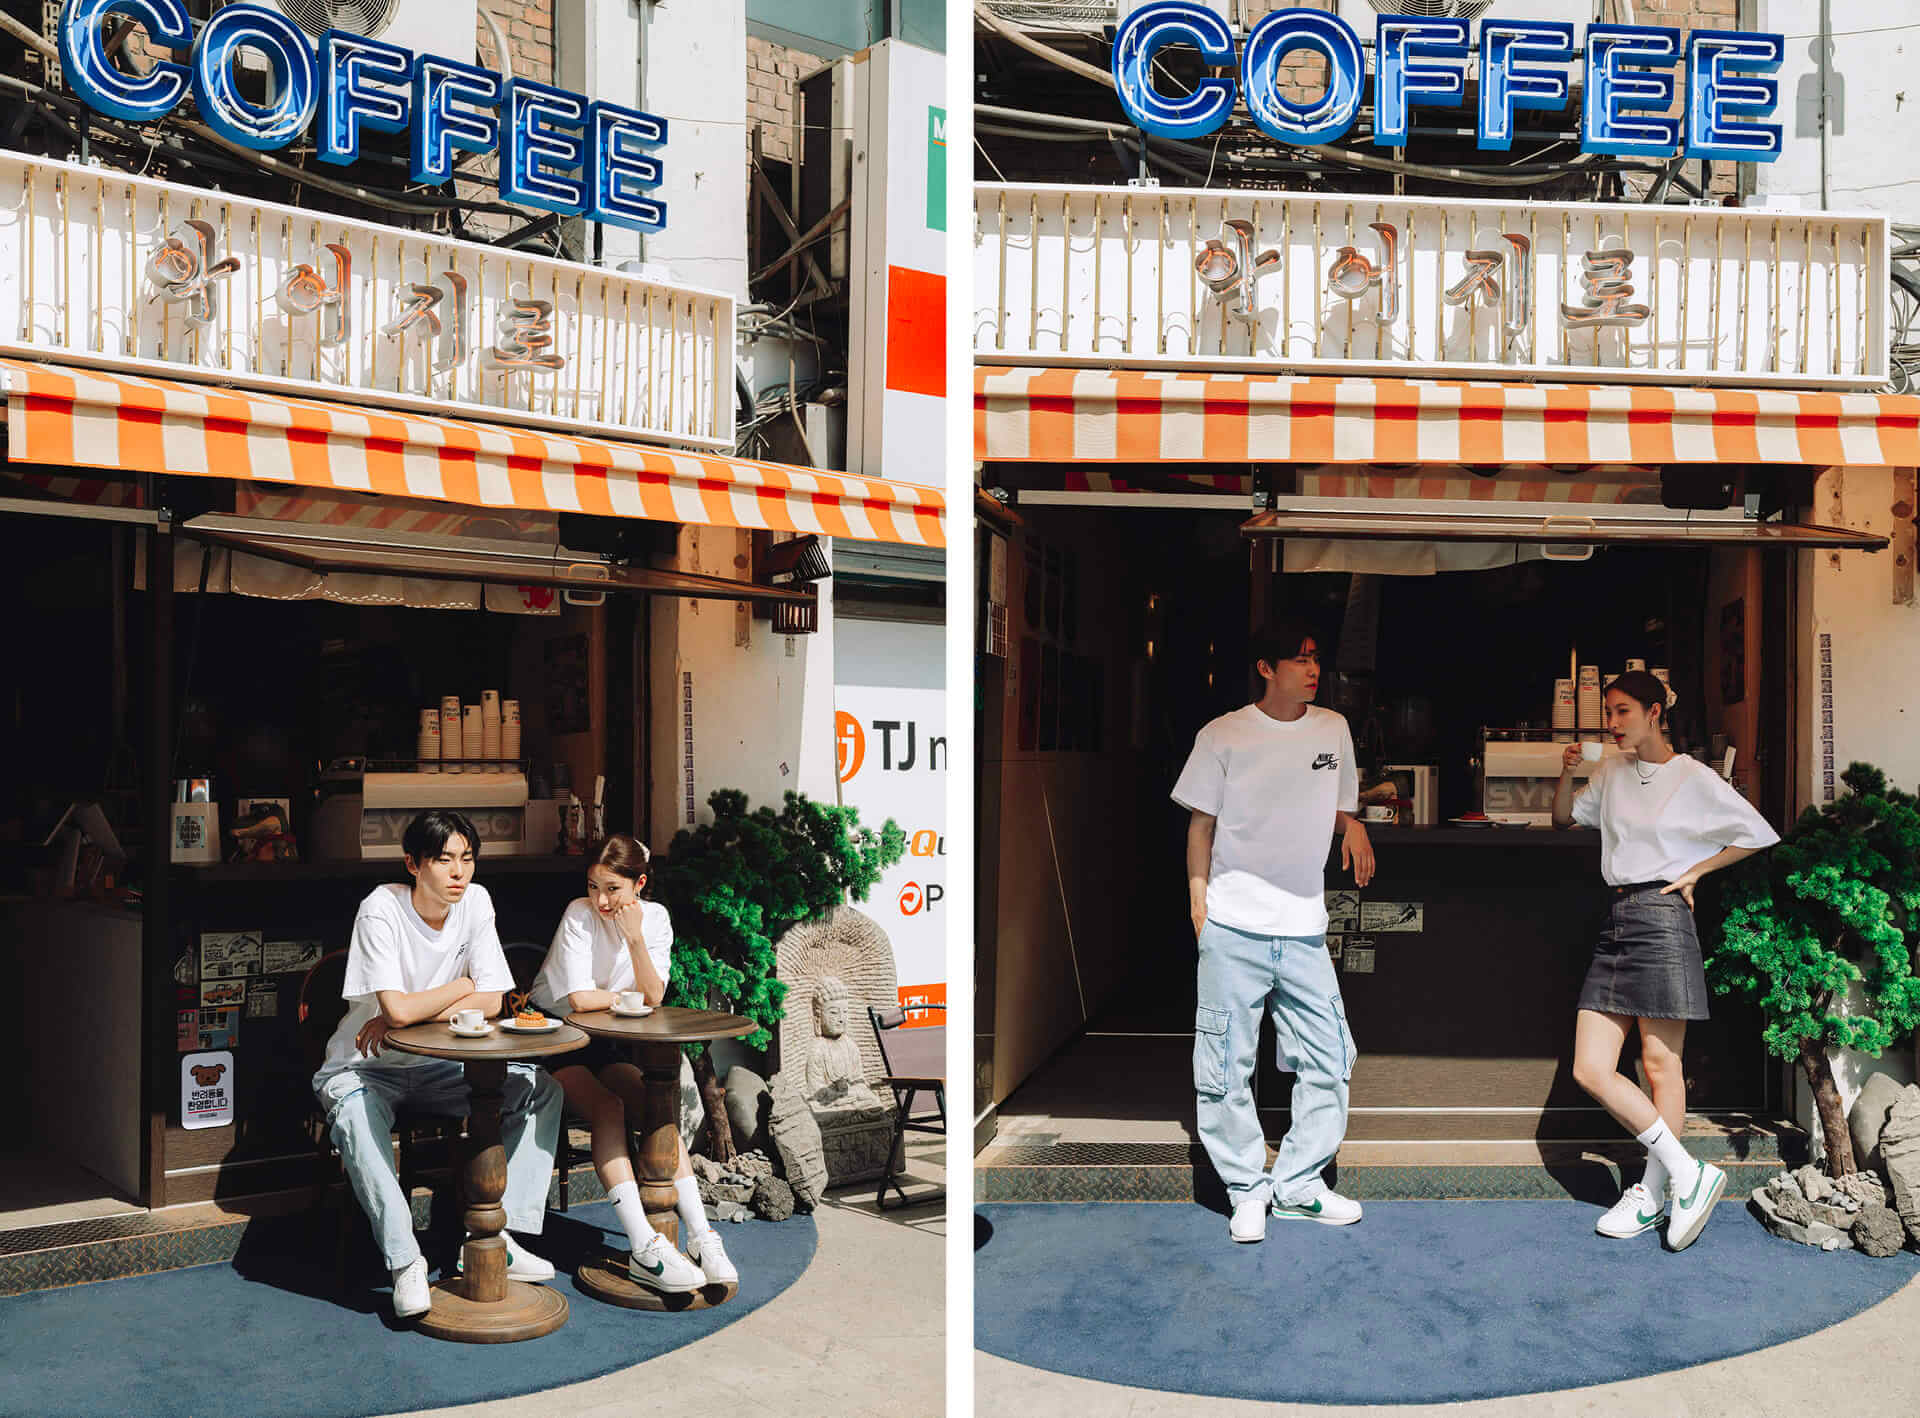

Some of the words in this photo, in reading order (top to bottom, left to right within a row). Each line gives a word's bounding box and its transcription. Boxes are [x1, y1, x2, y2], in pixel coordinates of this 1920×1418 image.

[58, 0, 668, 233] COFFEE
[1112, 1, 1785, 163] COFFEE
[872, 720, 916, 771] TJ
[1317, 752, 1336, 761] NIKE
